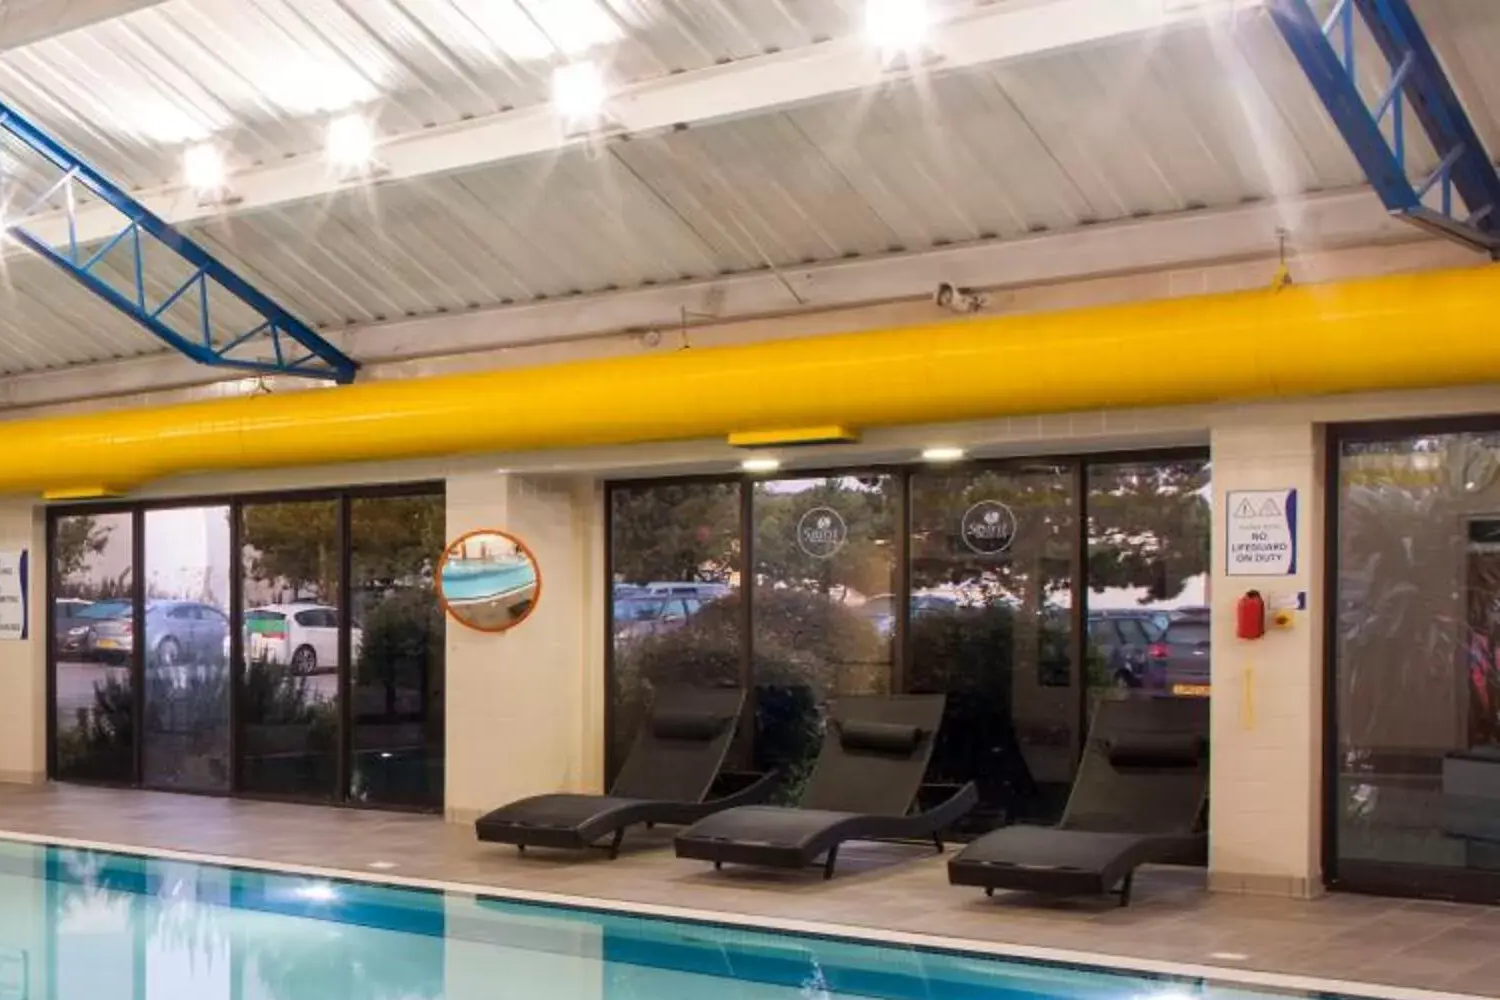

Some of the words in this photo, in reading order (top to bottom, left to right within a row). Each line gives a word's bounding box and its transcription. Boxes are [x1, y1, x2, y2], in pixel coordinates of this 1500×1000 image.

[1251, 532, 1268, 541] NO
[1231, 543, 1287, 552] LIFEGUARD
[1236, 554, 1253, 562] ON
[1255, 553, 1282, 562] DUTY
